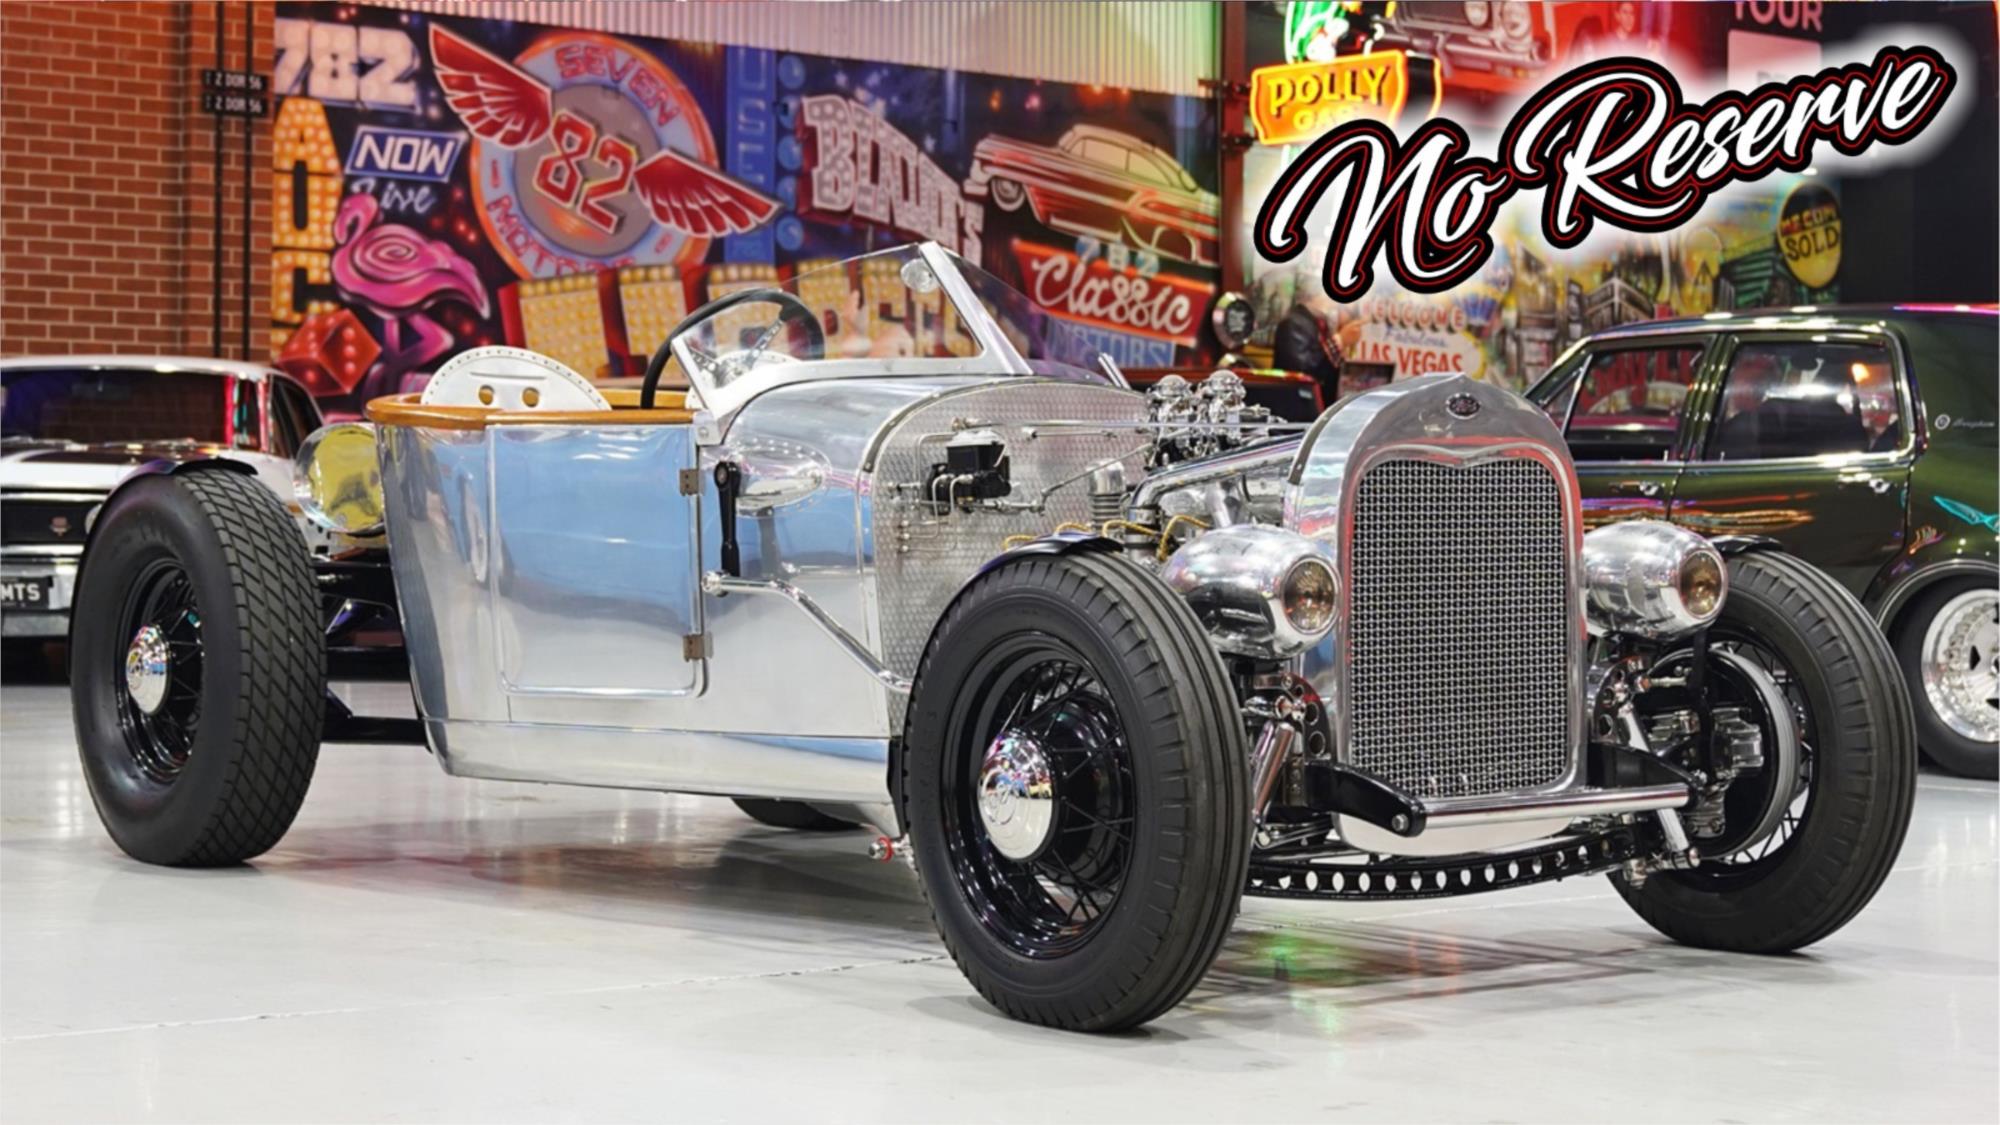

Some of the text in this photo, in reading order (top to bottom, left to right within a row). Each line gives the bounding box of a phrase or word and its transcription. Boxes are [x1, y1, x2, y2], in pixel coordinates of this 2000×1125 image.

[274, 18, 417, 107] 782
[555, 45, 681, 126] SEVEN
[1267, 66, 1389, 117] POLLY
[354, 134, 456, 176] NOW
[533, 109, 639, 235] 82
[487, 194, 637, 276] MOTO
[1784, 224, 1840, 262] SOLD
[1360, 341, 1463, 376] LAS VEGAS
[1, 583, 41, 601] MTS
